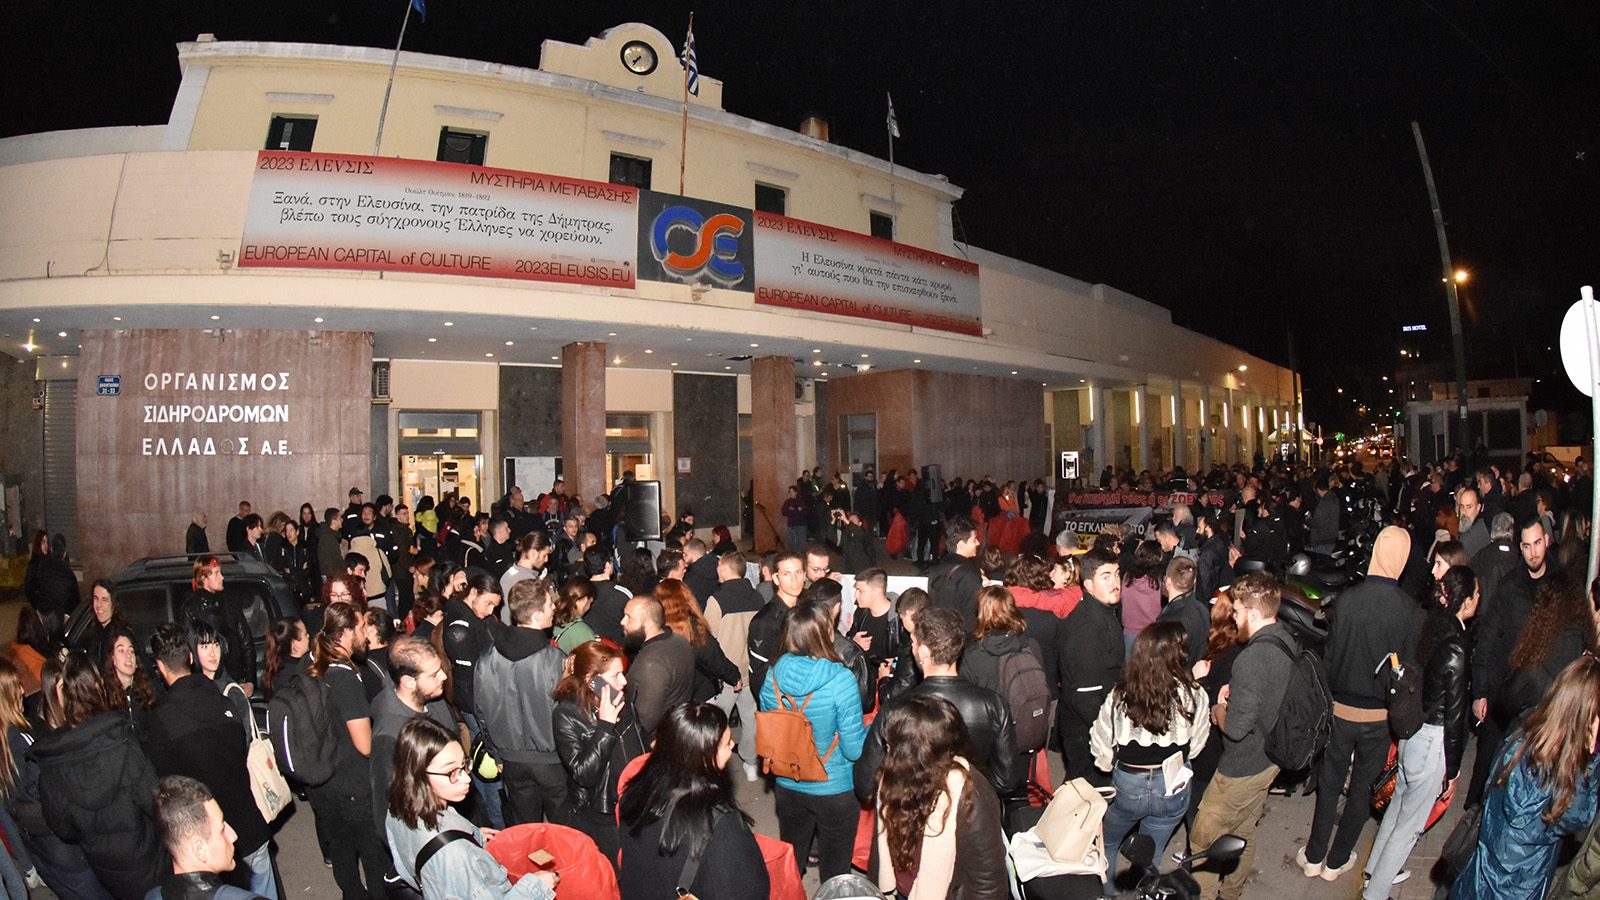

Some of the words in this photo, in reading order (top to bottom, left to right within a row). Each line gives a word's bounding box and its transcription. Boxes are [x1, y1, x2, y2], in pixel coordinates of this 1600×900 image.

[260, 157, 294, 170] 2023
[470, 171, 545, 192] ΜΥΣΤΗΡΙΑ
[549, 181, 632, 204] ΜΕΤΑΒΑΣΗΣ
[318, 196, 351, 210] στην
[430, 203, 453, 217] την
[459, 204, 516, 220] πατρίδα
[522, 212, 543, 226] της
[280, 208, 325, 225] βλέπω
[331, 213, 362, 228] τους
[367, 212, 451, 233] σύγχρονους
[454, 217, 513, 238] Έλληνες
[518, 228, 535, 238] να
[540, 229, 602, 245] χορεύουν.
[758, 216, 784, 232] 2023
[244, 245, 329, 262] EUROPEAN
[334, 247, 396, 265] CAPITAL
[401, 254, 416, 266] of
[420, 253, 492, 271] CULTURE
[802, 252, 810, 263] Η
[814, 253, 855, 272] Ελευσίνα
[515, 260, 630, 283] 2023ELEUSIS.EU
[807, 267, 841, 283] αυτούς
[843, 274, 860, 286] που
[863, 276, 874, 287] θα
[758, 286, 819, 306] EUROPEAN
[821, 295, 858, 312] CAPITAL
[872, 305, 912, 321] CULTURE
[144, 372, 290, 391] ΟΡΓΑΝΙΣΜΟΣ
[143, 404, 289, 423] ΣΙΔΗΡΟΔΡΟΜΩΝ
[261, 440, 293, 456] Α.Ε.
[1065, 521, 1077, 532] ΤΟ
